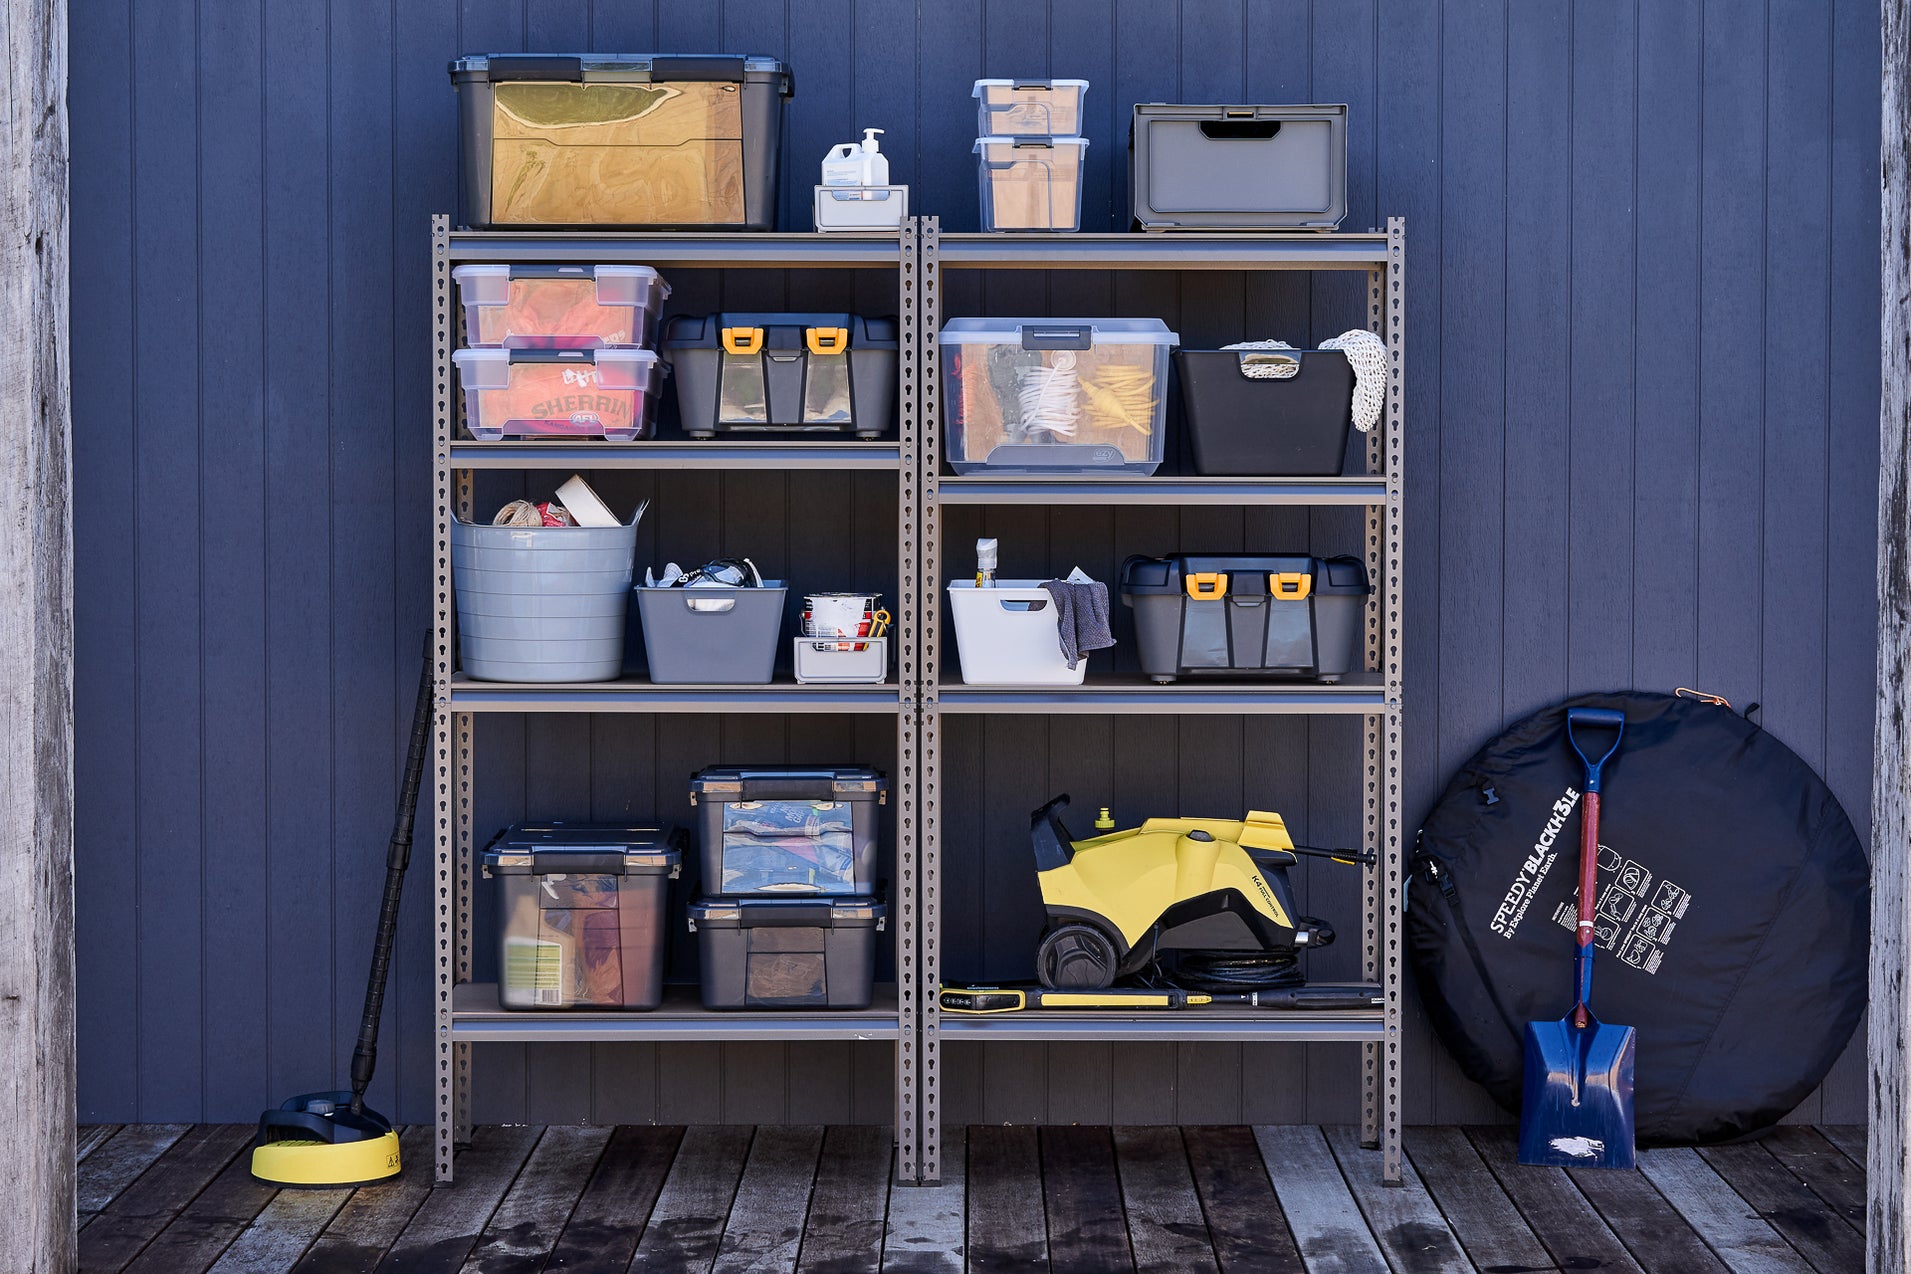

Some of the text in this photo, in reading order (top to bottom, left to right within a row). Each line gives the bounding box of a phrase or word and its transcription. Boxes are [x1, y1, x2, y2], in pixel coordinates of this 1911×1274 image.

[531, 394, 630, 419] SHERRIN
[574, 415, 597, 423] AFL
[1523, 787, 1580, 875] BLACKH3LE
[1252, 875, 1262, 887] K4
[1503, 852, 1558, 940] By Explore Planet Earth.
